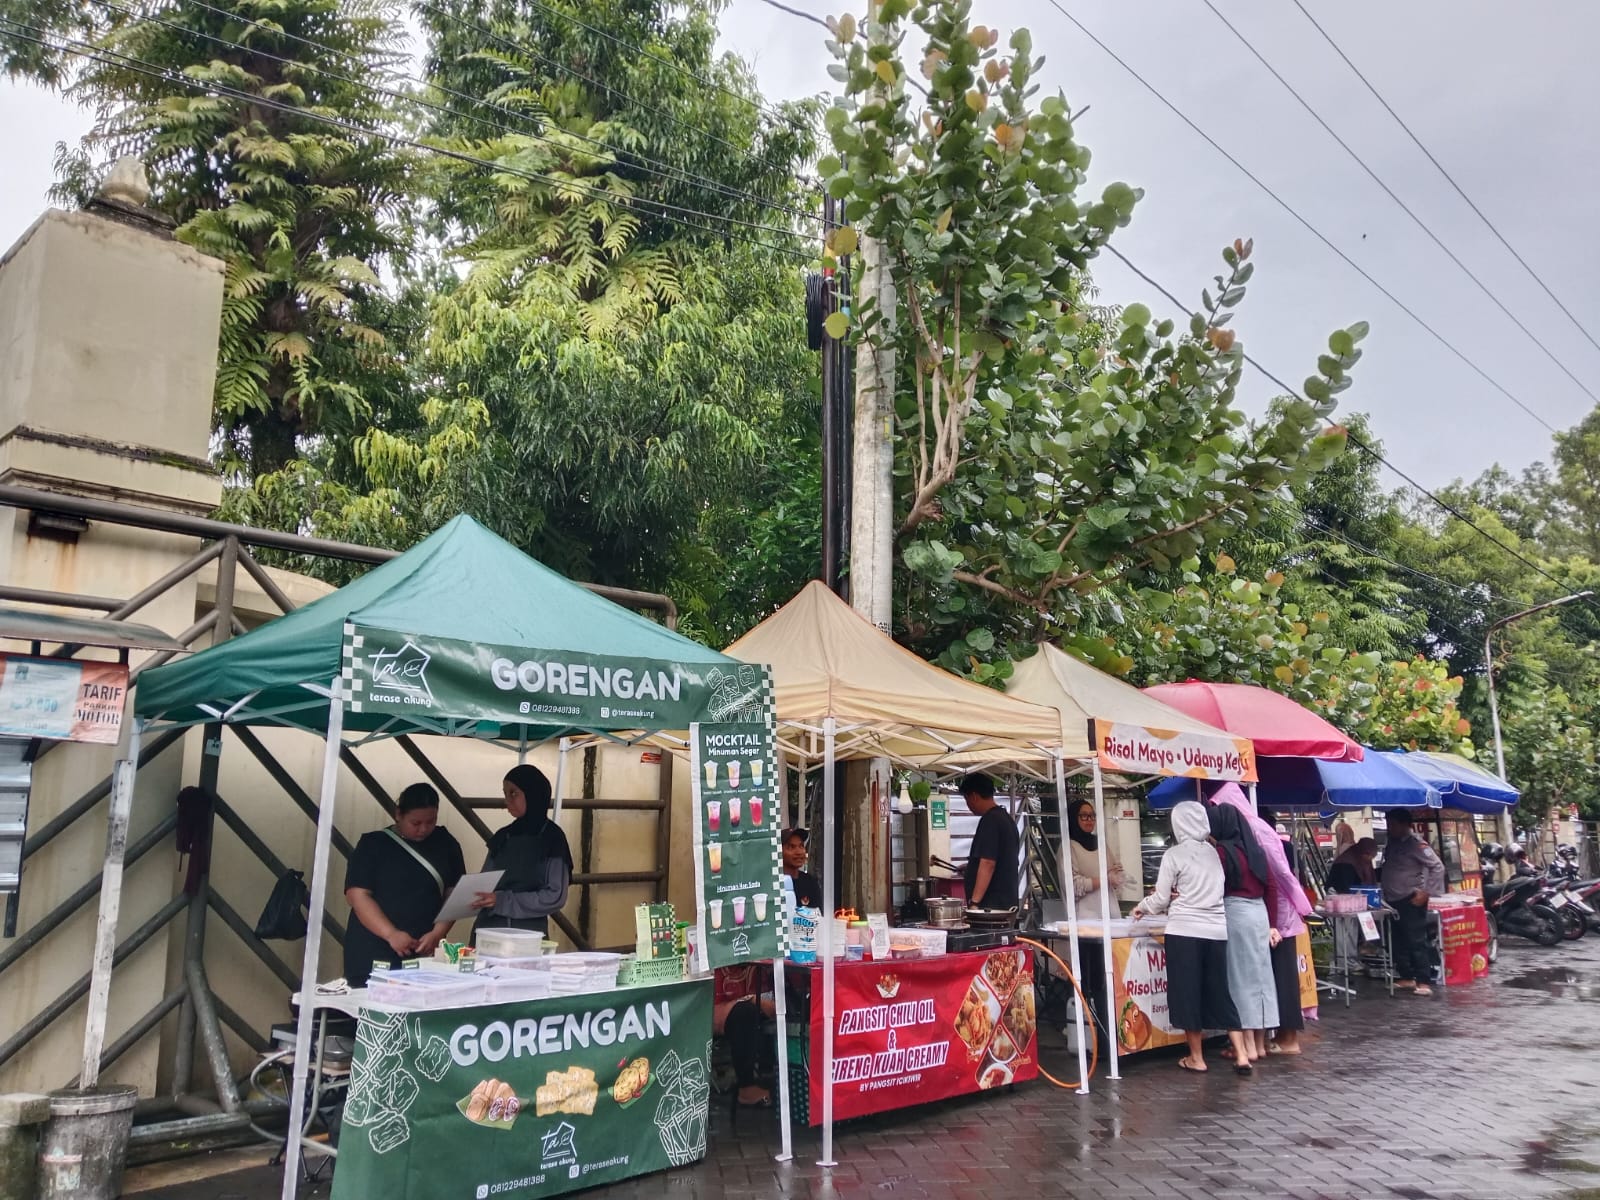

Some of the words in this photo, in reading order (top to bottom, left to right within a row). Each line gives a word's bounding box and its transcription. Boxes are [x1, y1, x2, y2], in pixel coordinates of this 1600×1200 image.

[490, 657, 681, 701] GORENGAN
[83, 683, 122, 701] TARIF
[77, 709, 120, 724] MOTOR
[705, 734, 761, 747] MOCKTAIL
[708, 747, 739, 756] Minuman
[740, 747, 760, 757] Segar
[1104, 736, 1135, 760] Risol
[1138, 741, 1174, 768] Mayo
[1183, 747, 1223, 772] Udang
[1225, 751, 1249, 775] Keju
[1146, 949, 1167, 973] MA
[1126, 978, 1153, 996] Risol
[1154, 977, 1168, 995] Ma
[838, 1005, 888, 1035] PANGSIT
[889, 1001, 917, 1027] CHILI
[917, 999, 935, 1023] OIL
[450, 1001, 671, 1067] GORENGAN
[887, 1029, 896, 1051] &
[872, 1049, 905, 1077] KUAH
[905, 1041, 949, 1072] CREAMY
[859, 1082, 869, 1092] BY
[869, 1077, 897, 1090] PANGSIT
